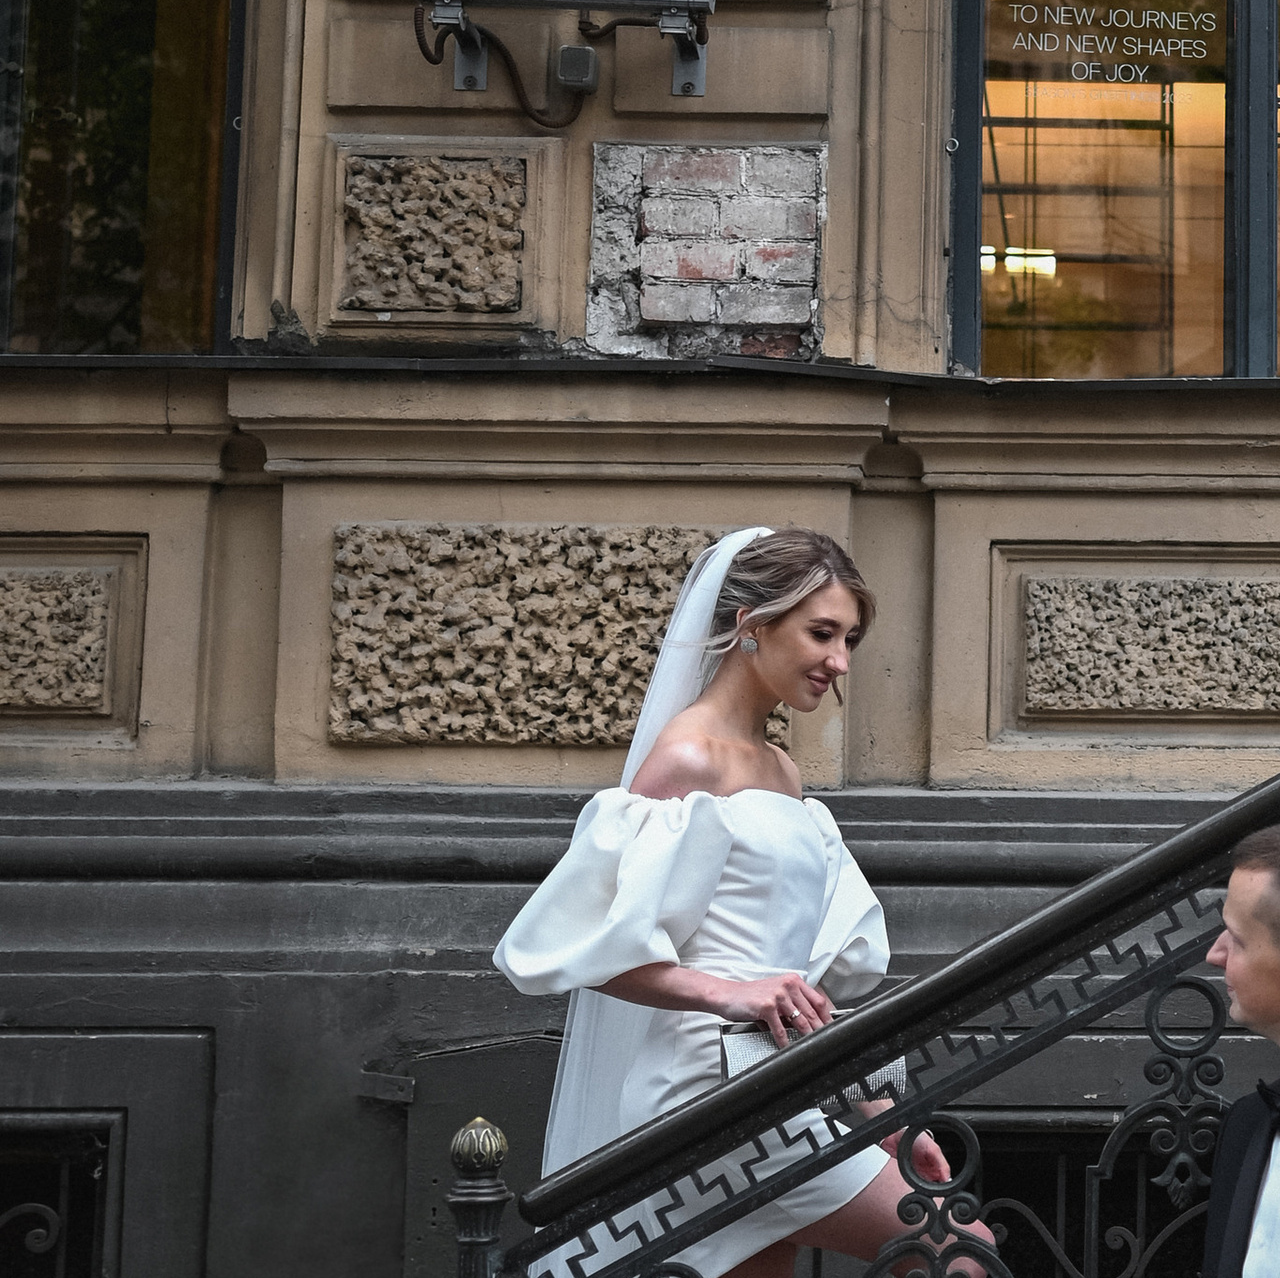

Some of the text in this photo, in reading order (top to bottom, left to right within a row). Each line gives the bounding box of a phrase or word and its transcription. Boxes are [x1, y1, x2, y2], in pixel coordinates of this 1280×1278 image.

[1009, 4, 1216, 32] TO NEW JOURNEYS
[1012, 32, 1207, 59] AND NEW SHAPES
[1071, 61, 1149, 83] OF JOY.
